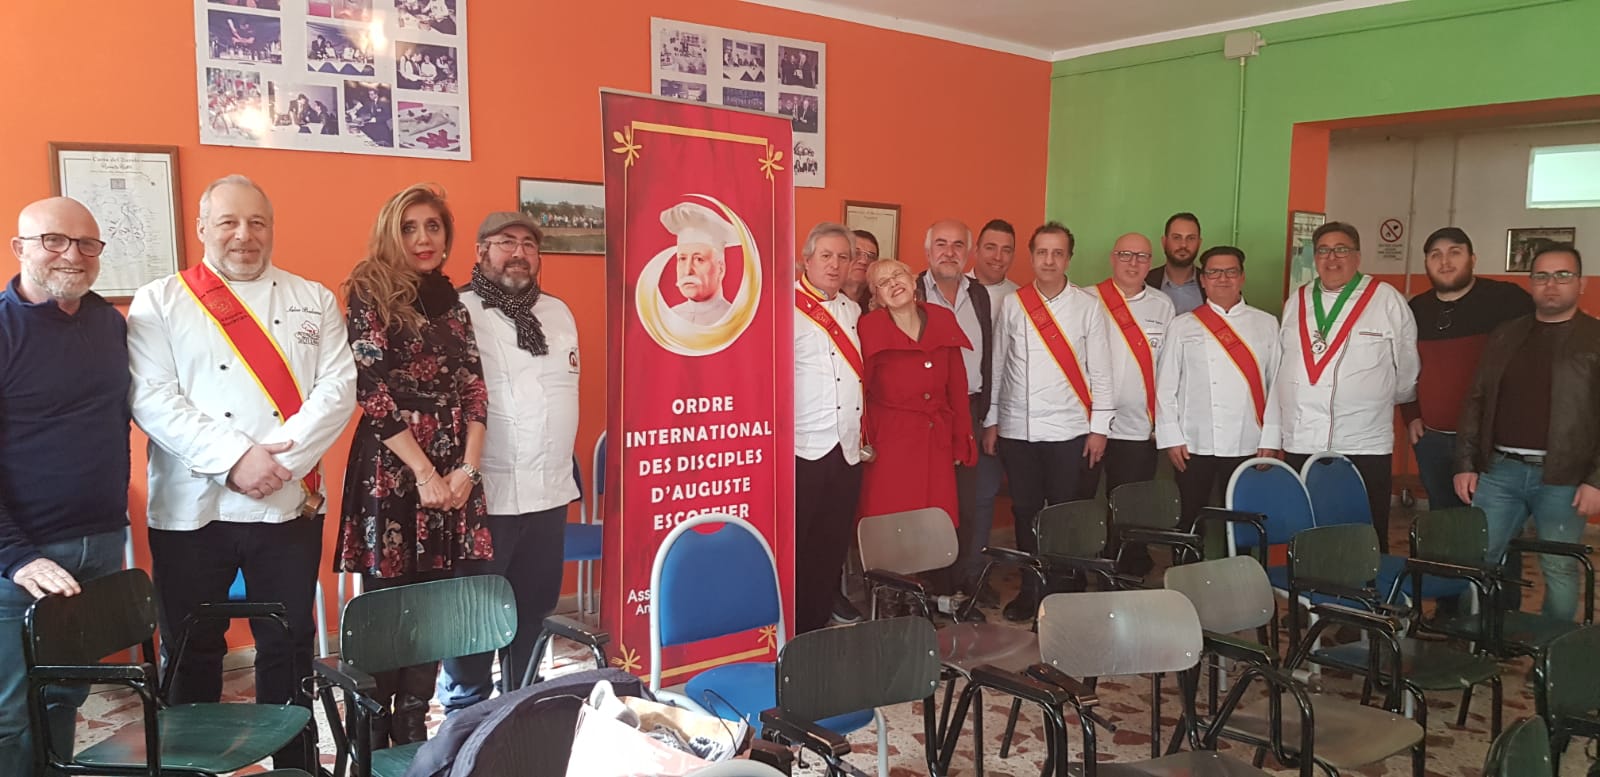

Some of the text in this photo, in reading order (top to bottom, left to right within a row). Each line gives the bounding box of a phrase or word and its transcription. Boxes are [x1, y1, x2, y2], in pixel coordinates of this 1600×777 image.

[672, 396, 734, 415] ORDRE
[626, 421, 772, 448] INTERNATIONAL
[639, 449, 763, 476] DES DISCIPLES
[651, 477, 751, 503] D’AUGUSTE
[627, 589, 651, 604] Ass
